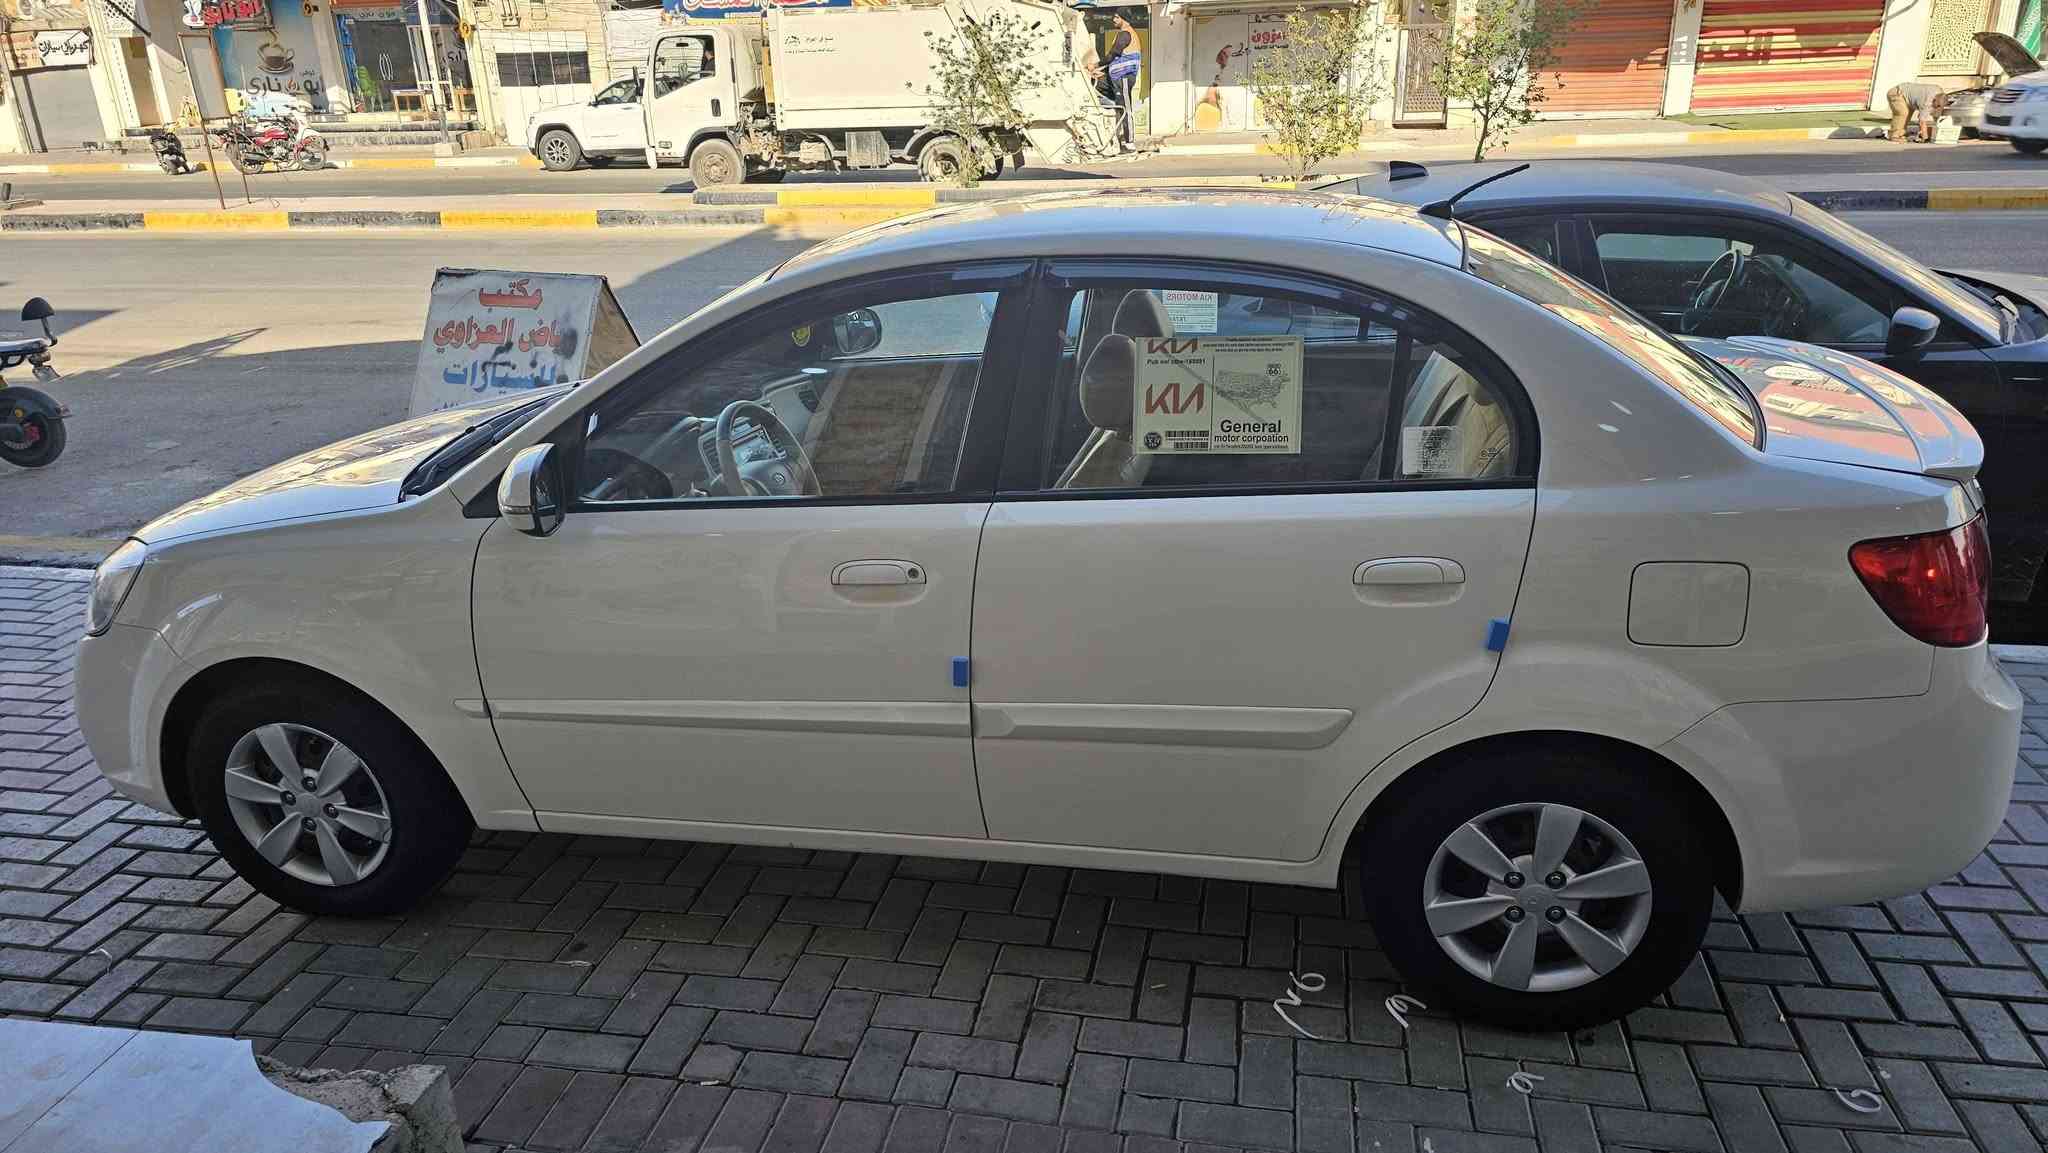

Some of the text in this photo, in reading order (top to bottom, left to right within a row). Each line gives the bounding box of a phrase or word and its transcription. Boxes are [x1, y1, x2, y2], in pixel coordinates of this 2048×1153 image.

[479, 279, 543, 313] مكتب
[1145, 383, 1205, 415] KIA
[1220, 419, 1282, 433] General
[1214, 433, 1239, 443] motor
